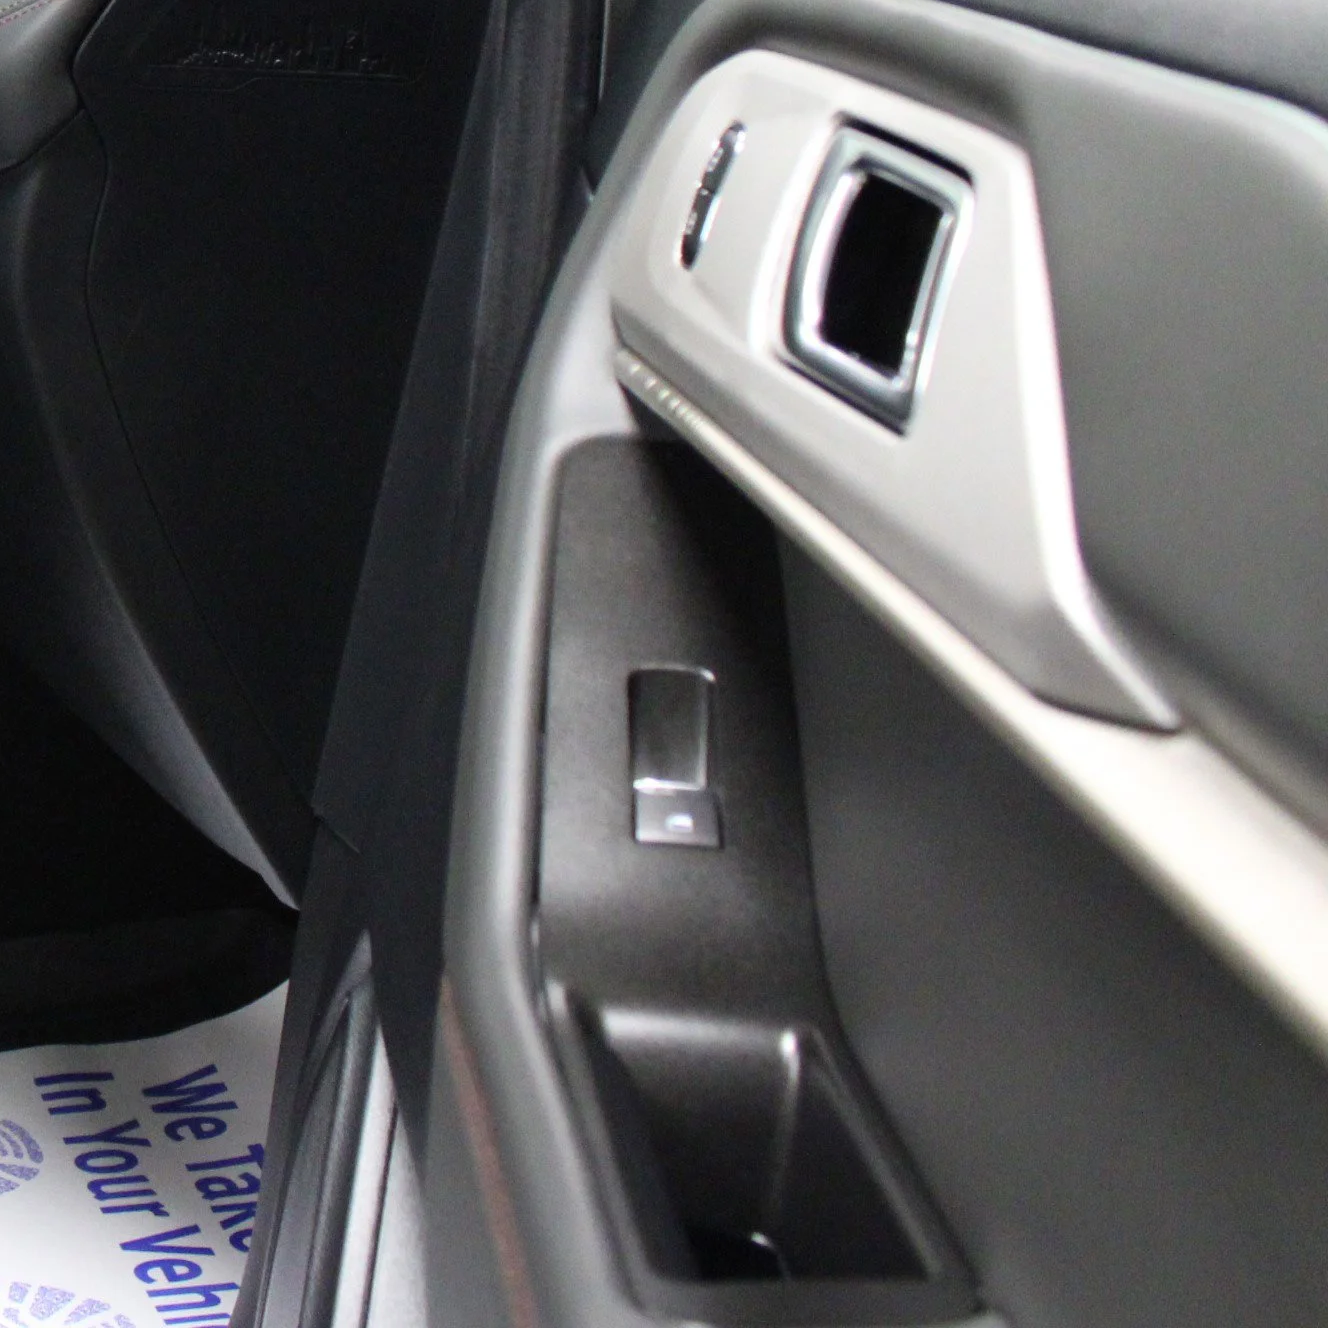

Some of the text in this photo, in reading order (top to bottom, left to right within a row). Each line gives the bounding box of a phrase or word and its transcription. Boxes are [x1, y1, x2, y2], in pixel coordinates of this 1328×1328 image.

[141, 1064, 239, 1142] We
[33, 1072, 241, 1328] In Your Vehi
